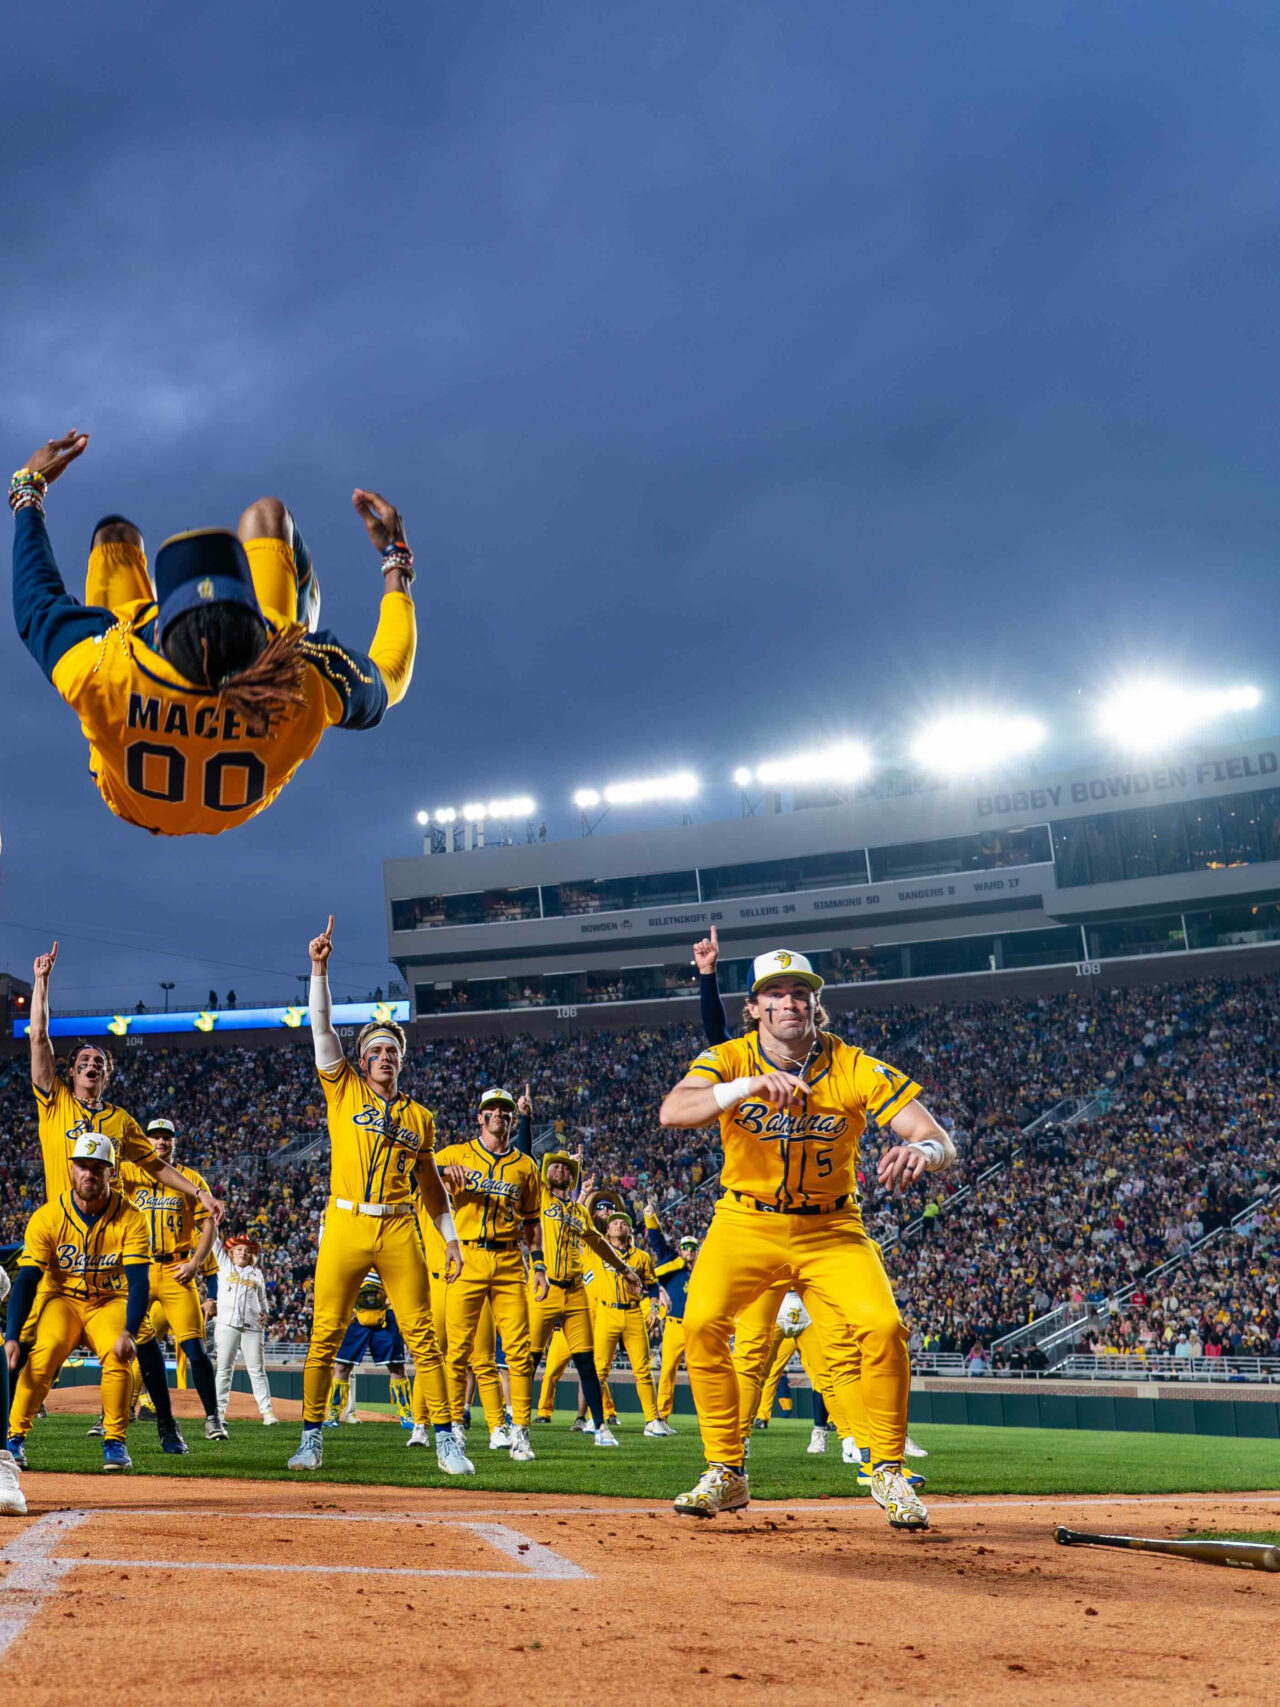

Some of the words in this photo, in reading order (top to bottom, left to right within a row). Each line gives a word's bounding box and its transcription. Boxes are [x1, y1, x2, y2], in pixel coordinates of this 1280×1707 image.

[124, 738, 267, 813] 00
[976, 786, 1062, 817] BOBBY
[1071, 766, 1187, 803] BOWDEN
[1196, 752, 1278, 785] FIELD
[973, 880, 1005, 892] WARD
[581, 922, 618, 933] BOWDEN
[1075, 963, 1101, 977] 108
[557, 1007, 577, 1018] 106
[126, 1036, 144, 1047] 104
[352, 1104, 420, 1152] Bananas
[733, 1102, 849, 1142] Bananas
[396, 1150, 408, 1174] 8
[816, 1148, 834, 1178] 5
[464, 1170, 521, 1202] Bananas
[134, 1189, 184, 1211] Bananas
[166, 1215, 184, 1232] 44
[503, 1202, 515, 1223] 3
